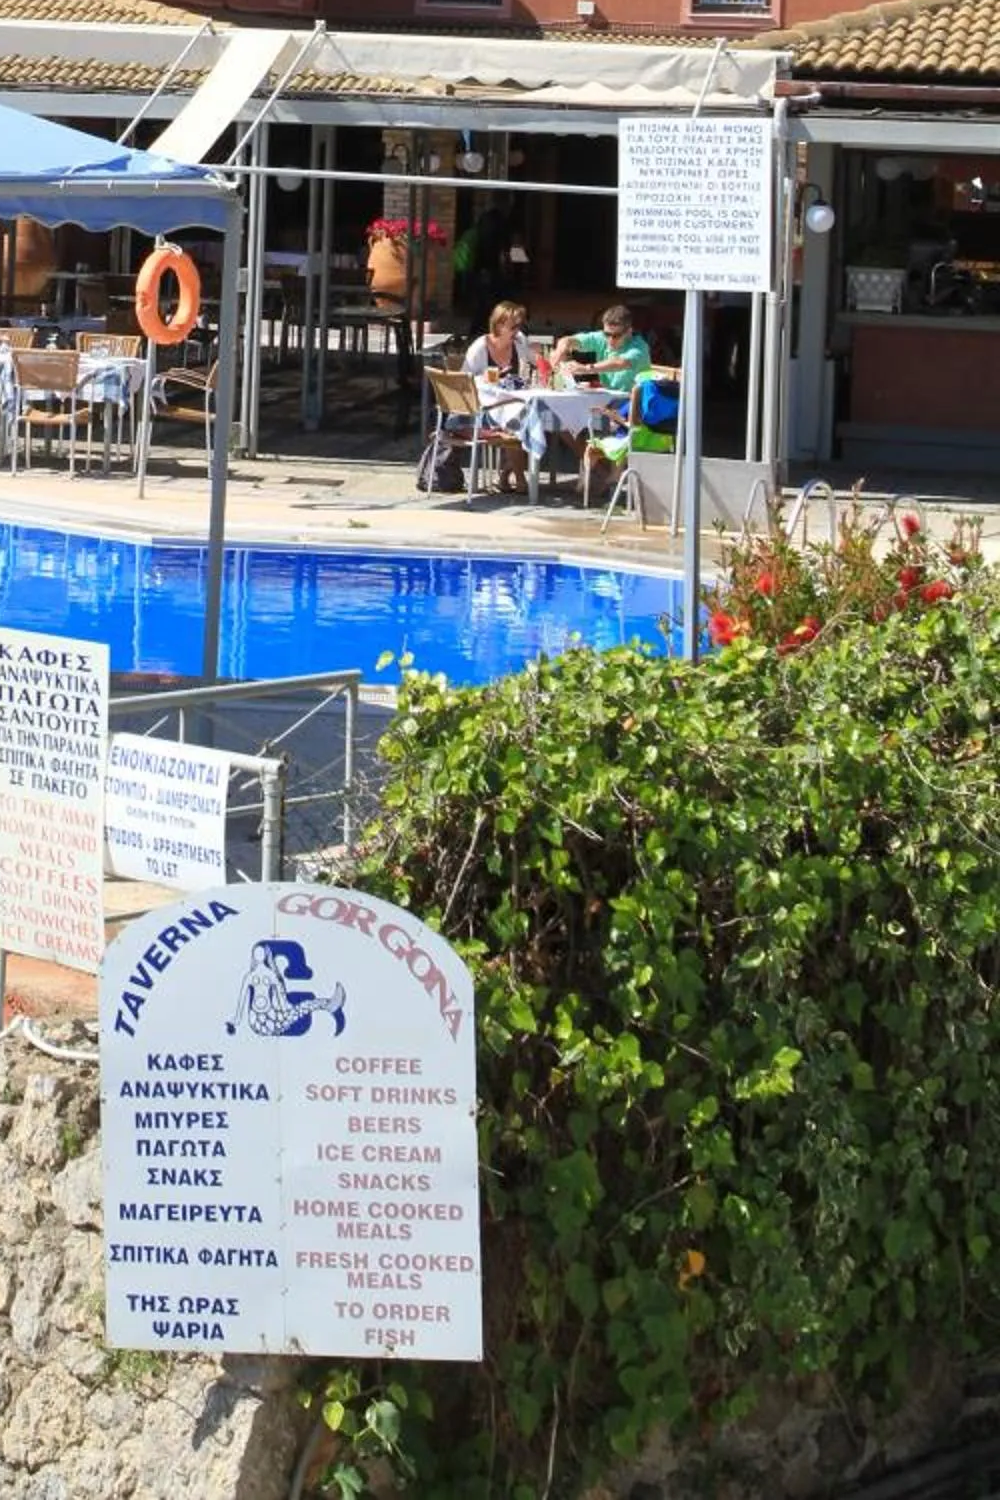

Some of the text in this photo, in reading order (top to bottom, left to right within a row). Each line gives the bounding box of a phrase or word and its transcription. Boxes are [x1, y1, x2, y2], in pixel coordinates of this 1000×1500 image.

[639, 123, 679, 133] ΠΙΣΙΝΑ
[655, 157, 702, 167] ΠΙΣΙΝΑΣ
[686, 209, 713, 218] POOL
[718, 210, 728, 219] IS
[732, 210, 760, 219] ONLY
[634, 219, 754, 229] FOR OUR CUSTOMERS
[677, 234, 702, 243] POOL
[643, 260, 684, 269] DIVING
[111, 745, 220, 786] ΕΝΟΙΚΙΑΖΟΝΤΑΙ
[9, 769, 88, 799] ΣΕ ΠΑΚΕΤΟ
[0, 856, 98, 896] COFFEES
[41, 889, 98, 918] DRINKS
[114, 899, 240, 1038] TAVERNA
[148, 1054, 225, 1071] ΚΑΦΕΣ
[335, 1056, 423, 1075] COFFEE
[119, 1080, 270, 1101] ΑΝΑΨΥΚΤΙΚΑ
[305, 1083, 457, 1105] SOFT DRINKS
[135, 1111, 229, 1129] ΜΠΥΡΕΣ
[347, 1115, 422, 1134] BEERS
[136, 1139, 226, 1157] ΠΑΓΩΤΑ
[316, 1143, 442, 1164] ICE CREAM
[146, 1168, 223, 1187] ΣΝΑΚΣ
[337, 1173, 431, 1192] SNACKS
[119, 1203, 263, 1223] ΜΑΓΕΙΡΕΥΤΑ
[293, 1199, 464, 1221] HOME COOKED
[337, 1222, 412, 1241] MEALS
[109, 1244, 278, 1268] ΣΠΙΤΙΚΑ ΦΑΓΗΤΑ
[295, 1251, 474, 1272] FRESH COOKED
[347, 1272, 423, 1290] MEALS
[126, 1294, 240, 1316] ΤΗΣ ΩΡΑΣ
[334, 1301, 450, 1322] TO ORDER
[153, 1321, 225, 1340] ΨΑΡΙΑ
[365, 1328, 415, 1346] FISH
